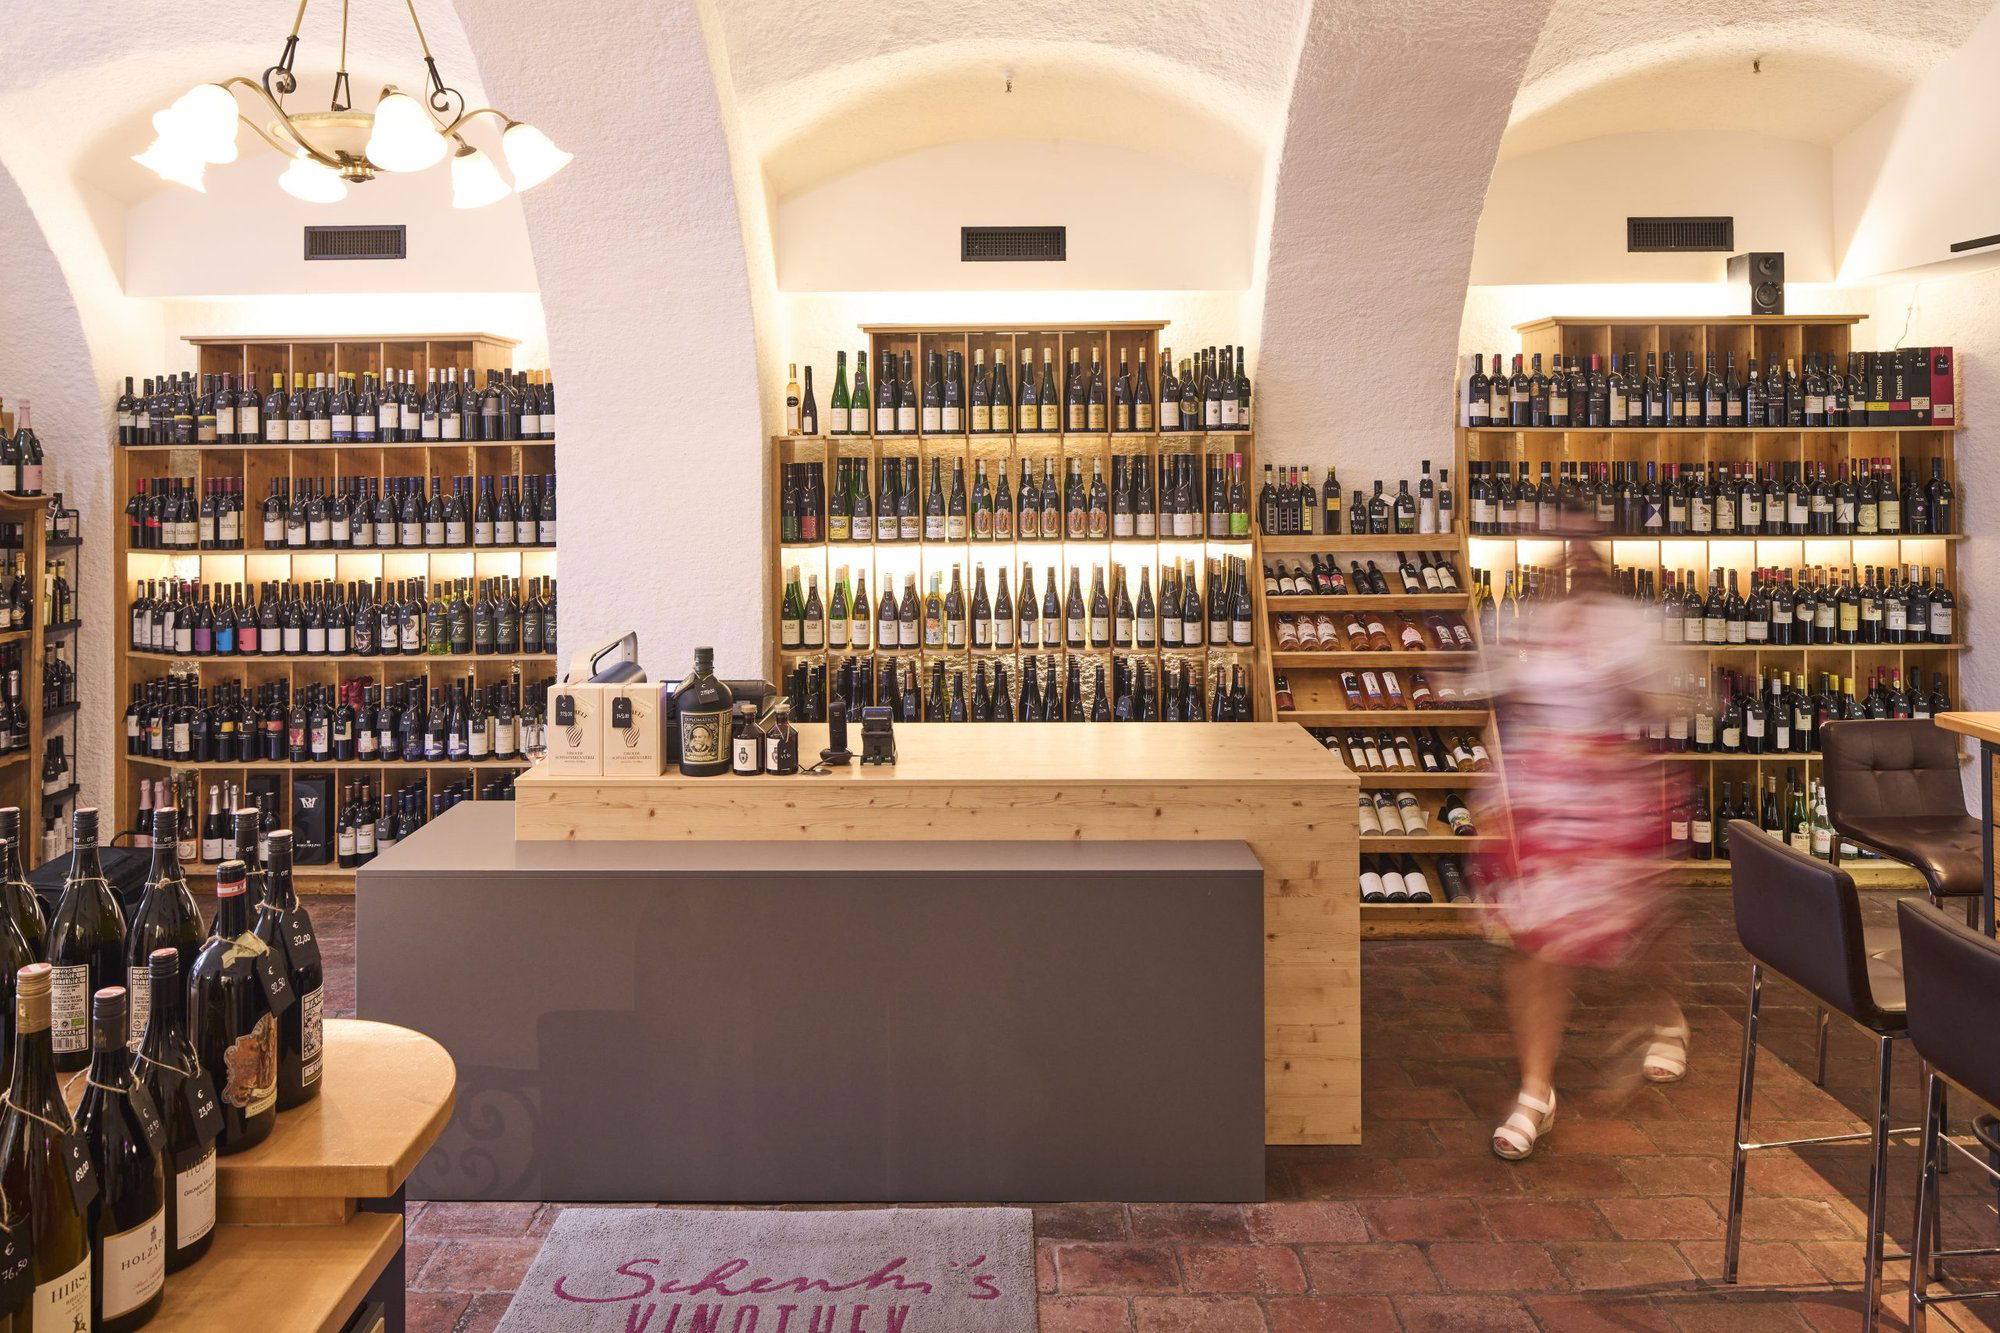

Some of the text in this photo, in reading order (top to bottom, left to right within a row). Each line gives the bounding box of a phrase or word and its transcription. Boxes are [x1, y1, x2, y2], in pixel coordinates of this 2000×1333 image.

[1895, 375, 1903, 400] Ramos
[293, 933, 311, 946] 32,00
[198, 1101, 214, 1118] 23,00
[75, 1160, 90, 1183] 69,00
[1, 1258, 28, 1282] 76,50
